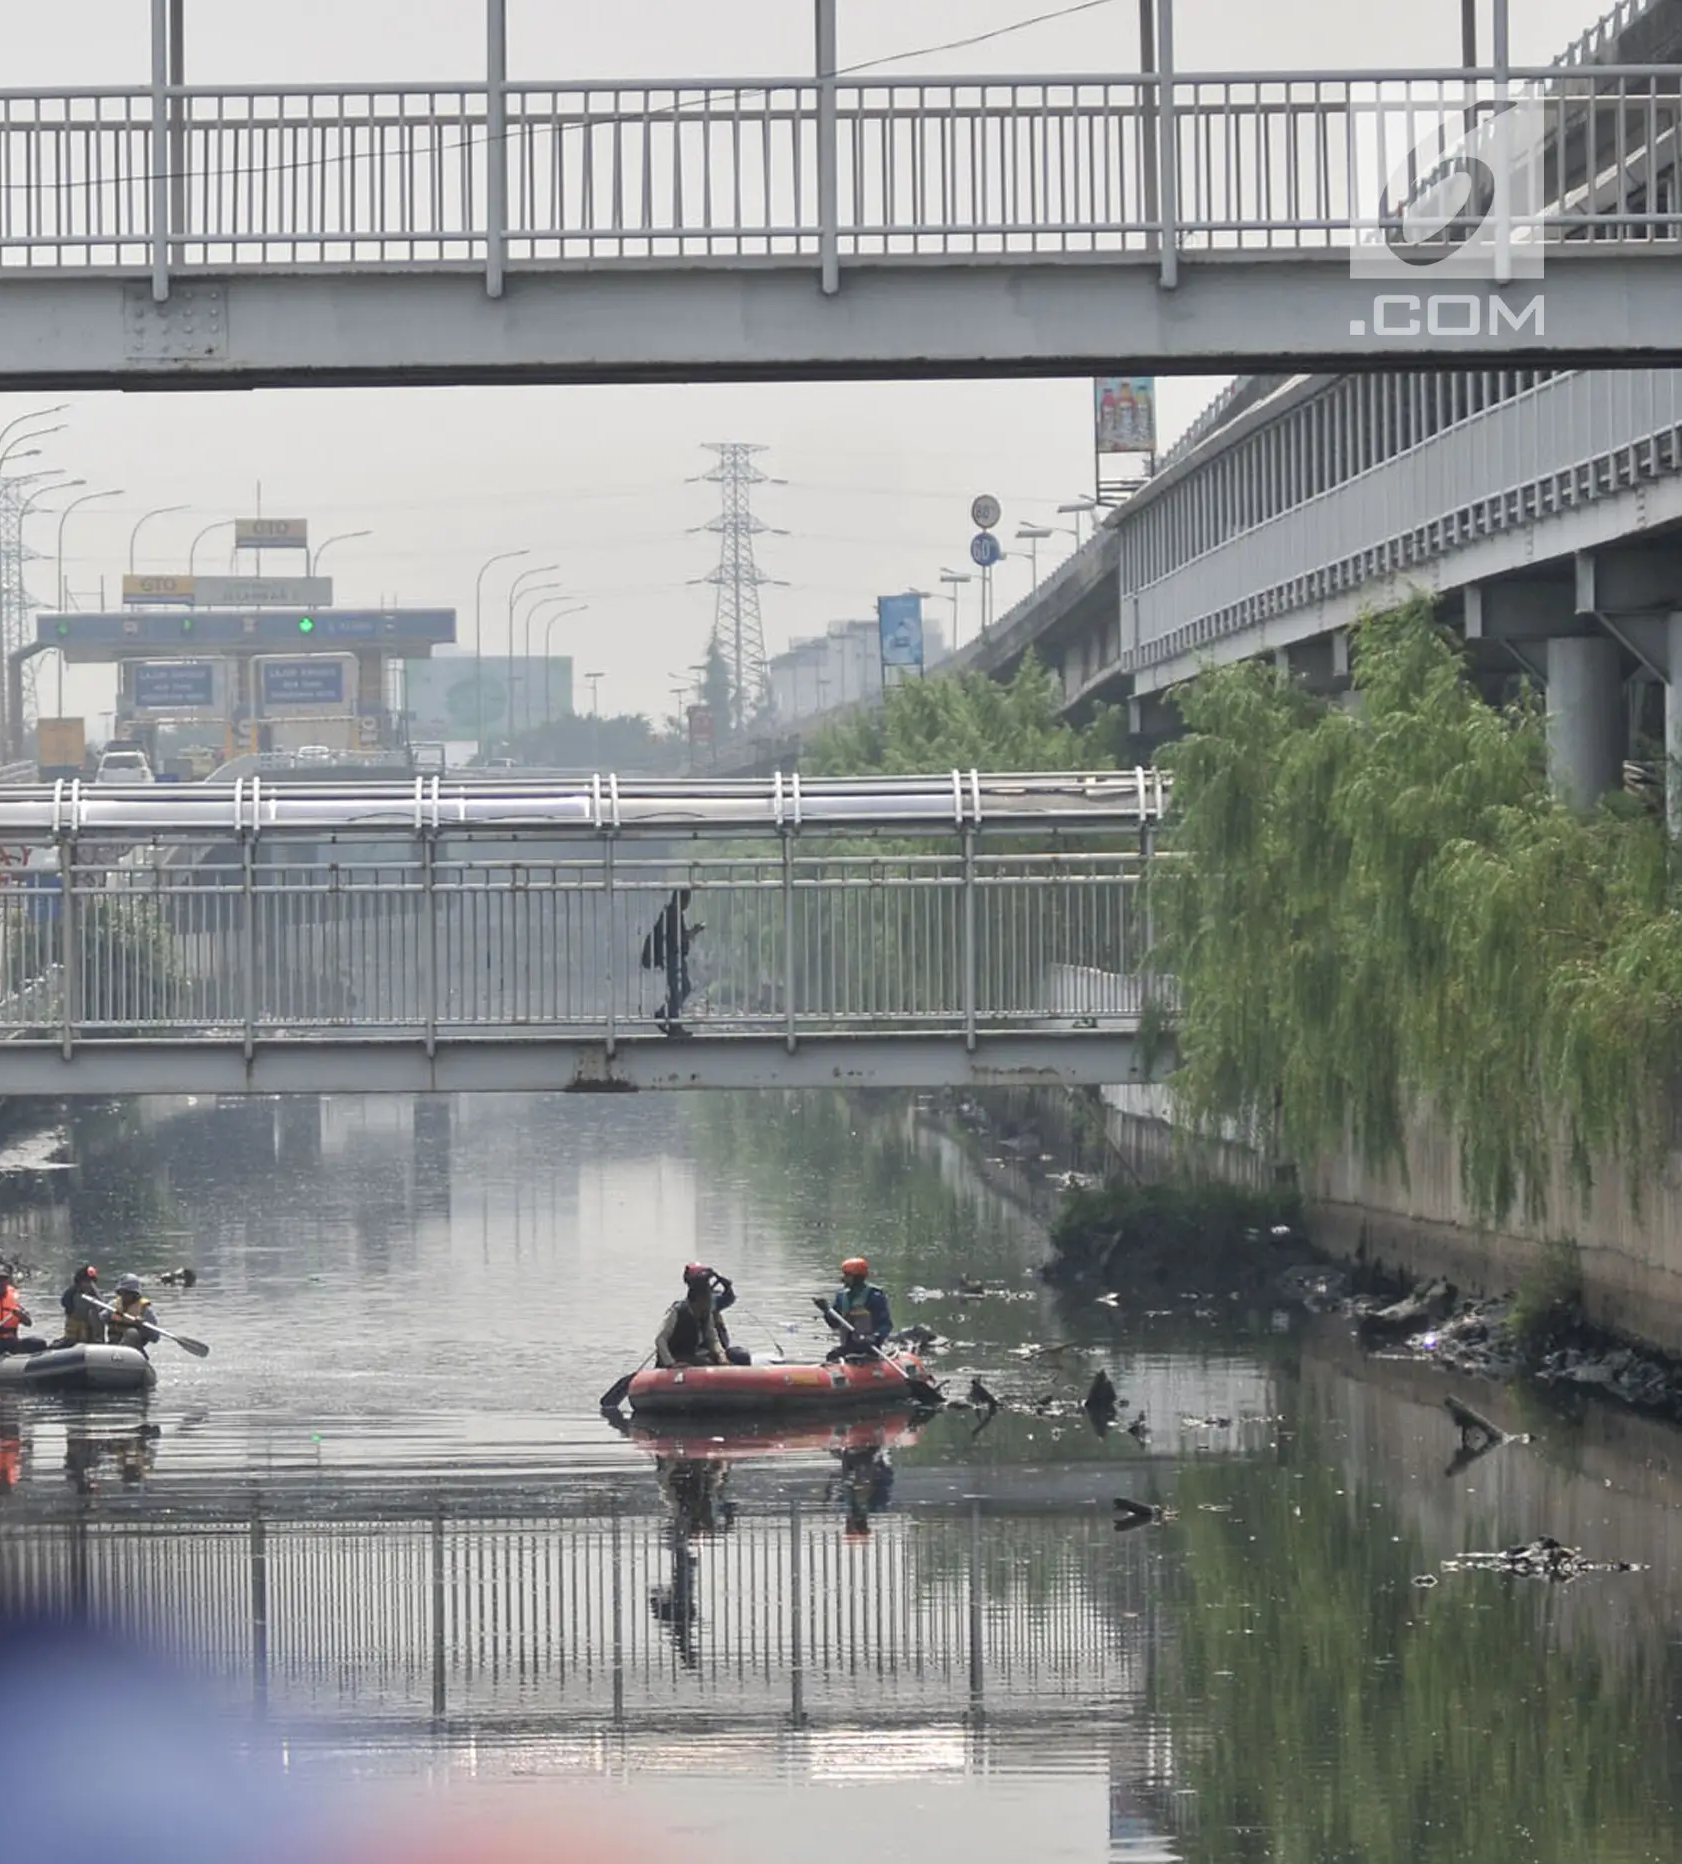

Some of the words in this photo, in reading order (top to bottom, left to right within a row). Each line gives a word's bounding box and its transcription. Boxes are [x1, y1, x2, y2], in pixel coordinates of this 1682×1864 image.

[253, 520, 289, 535] GTO
[973, 538, 991, 561] 60
[140, 577, 177, 592] GTO
